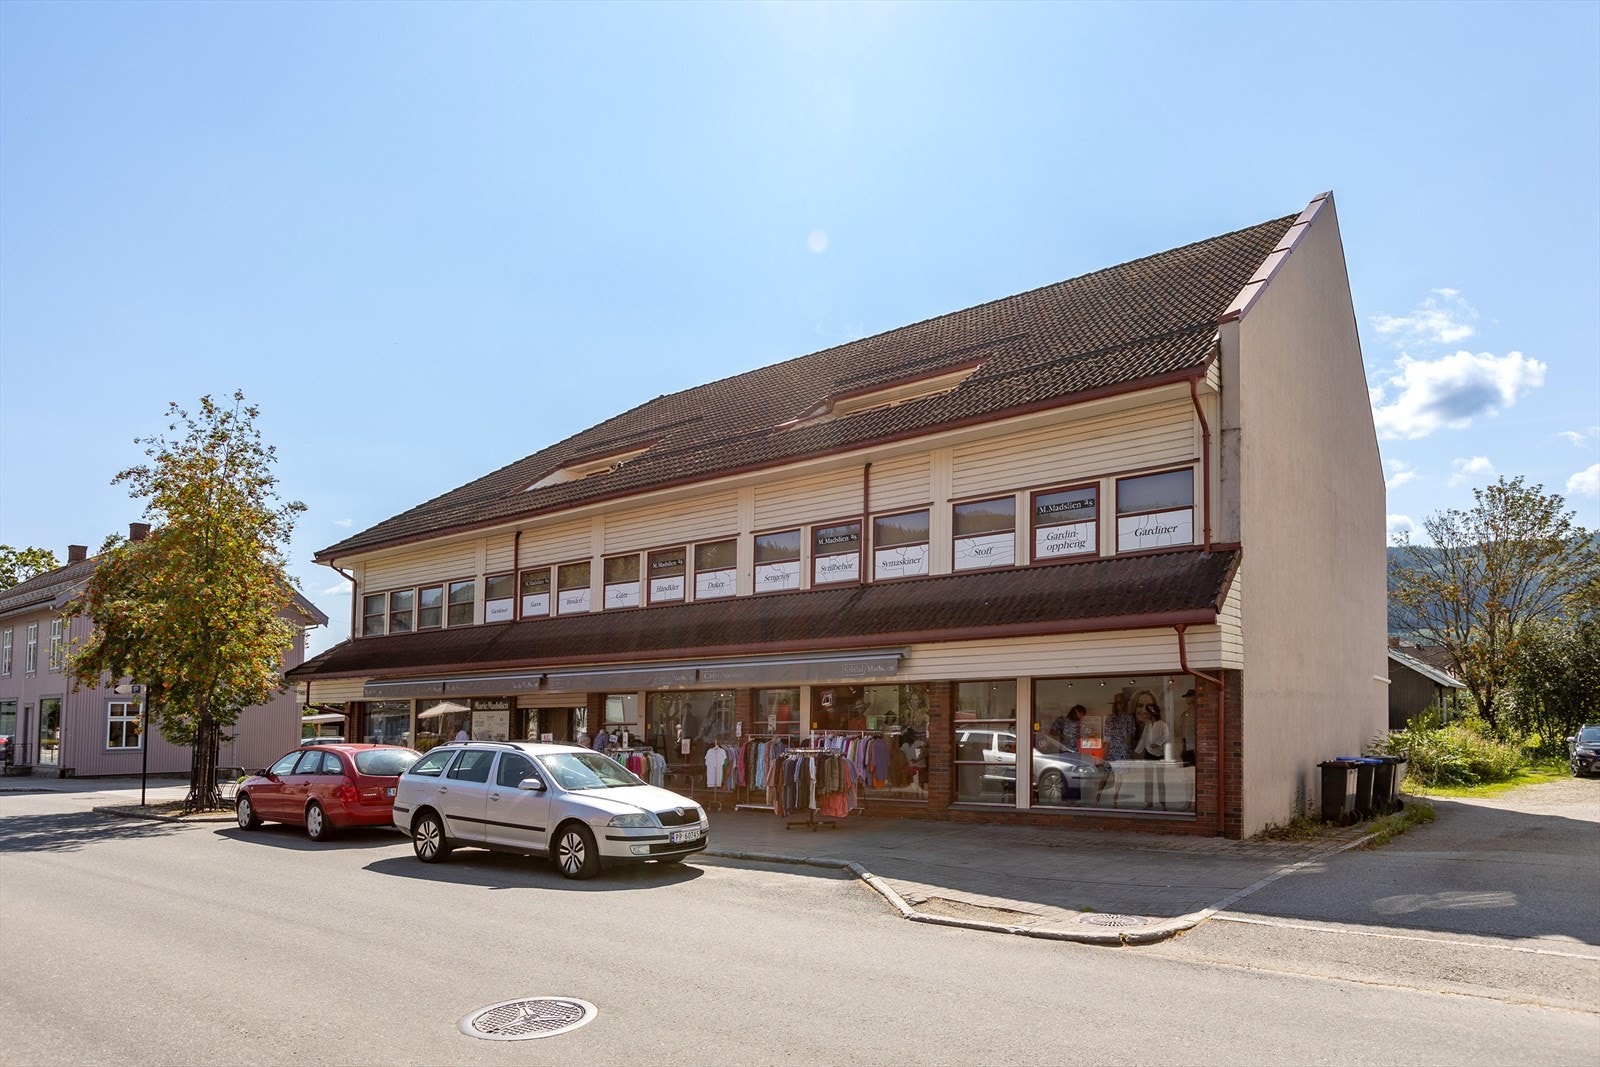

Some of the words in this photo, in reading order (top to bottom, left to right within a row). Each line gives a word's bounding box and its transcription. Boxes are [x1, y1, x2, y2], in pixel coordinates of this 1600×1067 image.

[1047, 530, 1079, 541] Gardin-
[1134, 524, 1178, 537] Gardiner
[1047, 539, 1086, 552] oppheng
[974, 547, 993, 557] Stoff
[881, 557, 921, 570] Symaskiner
[708, 581, 725, 589] Duker
